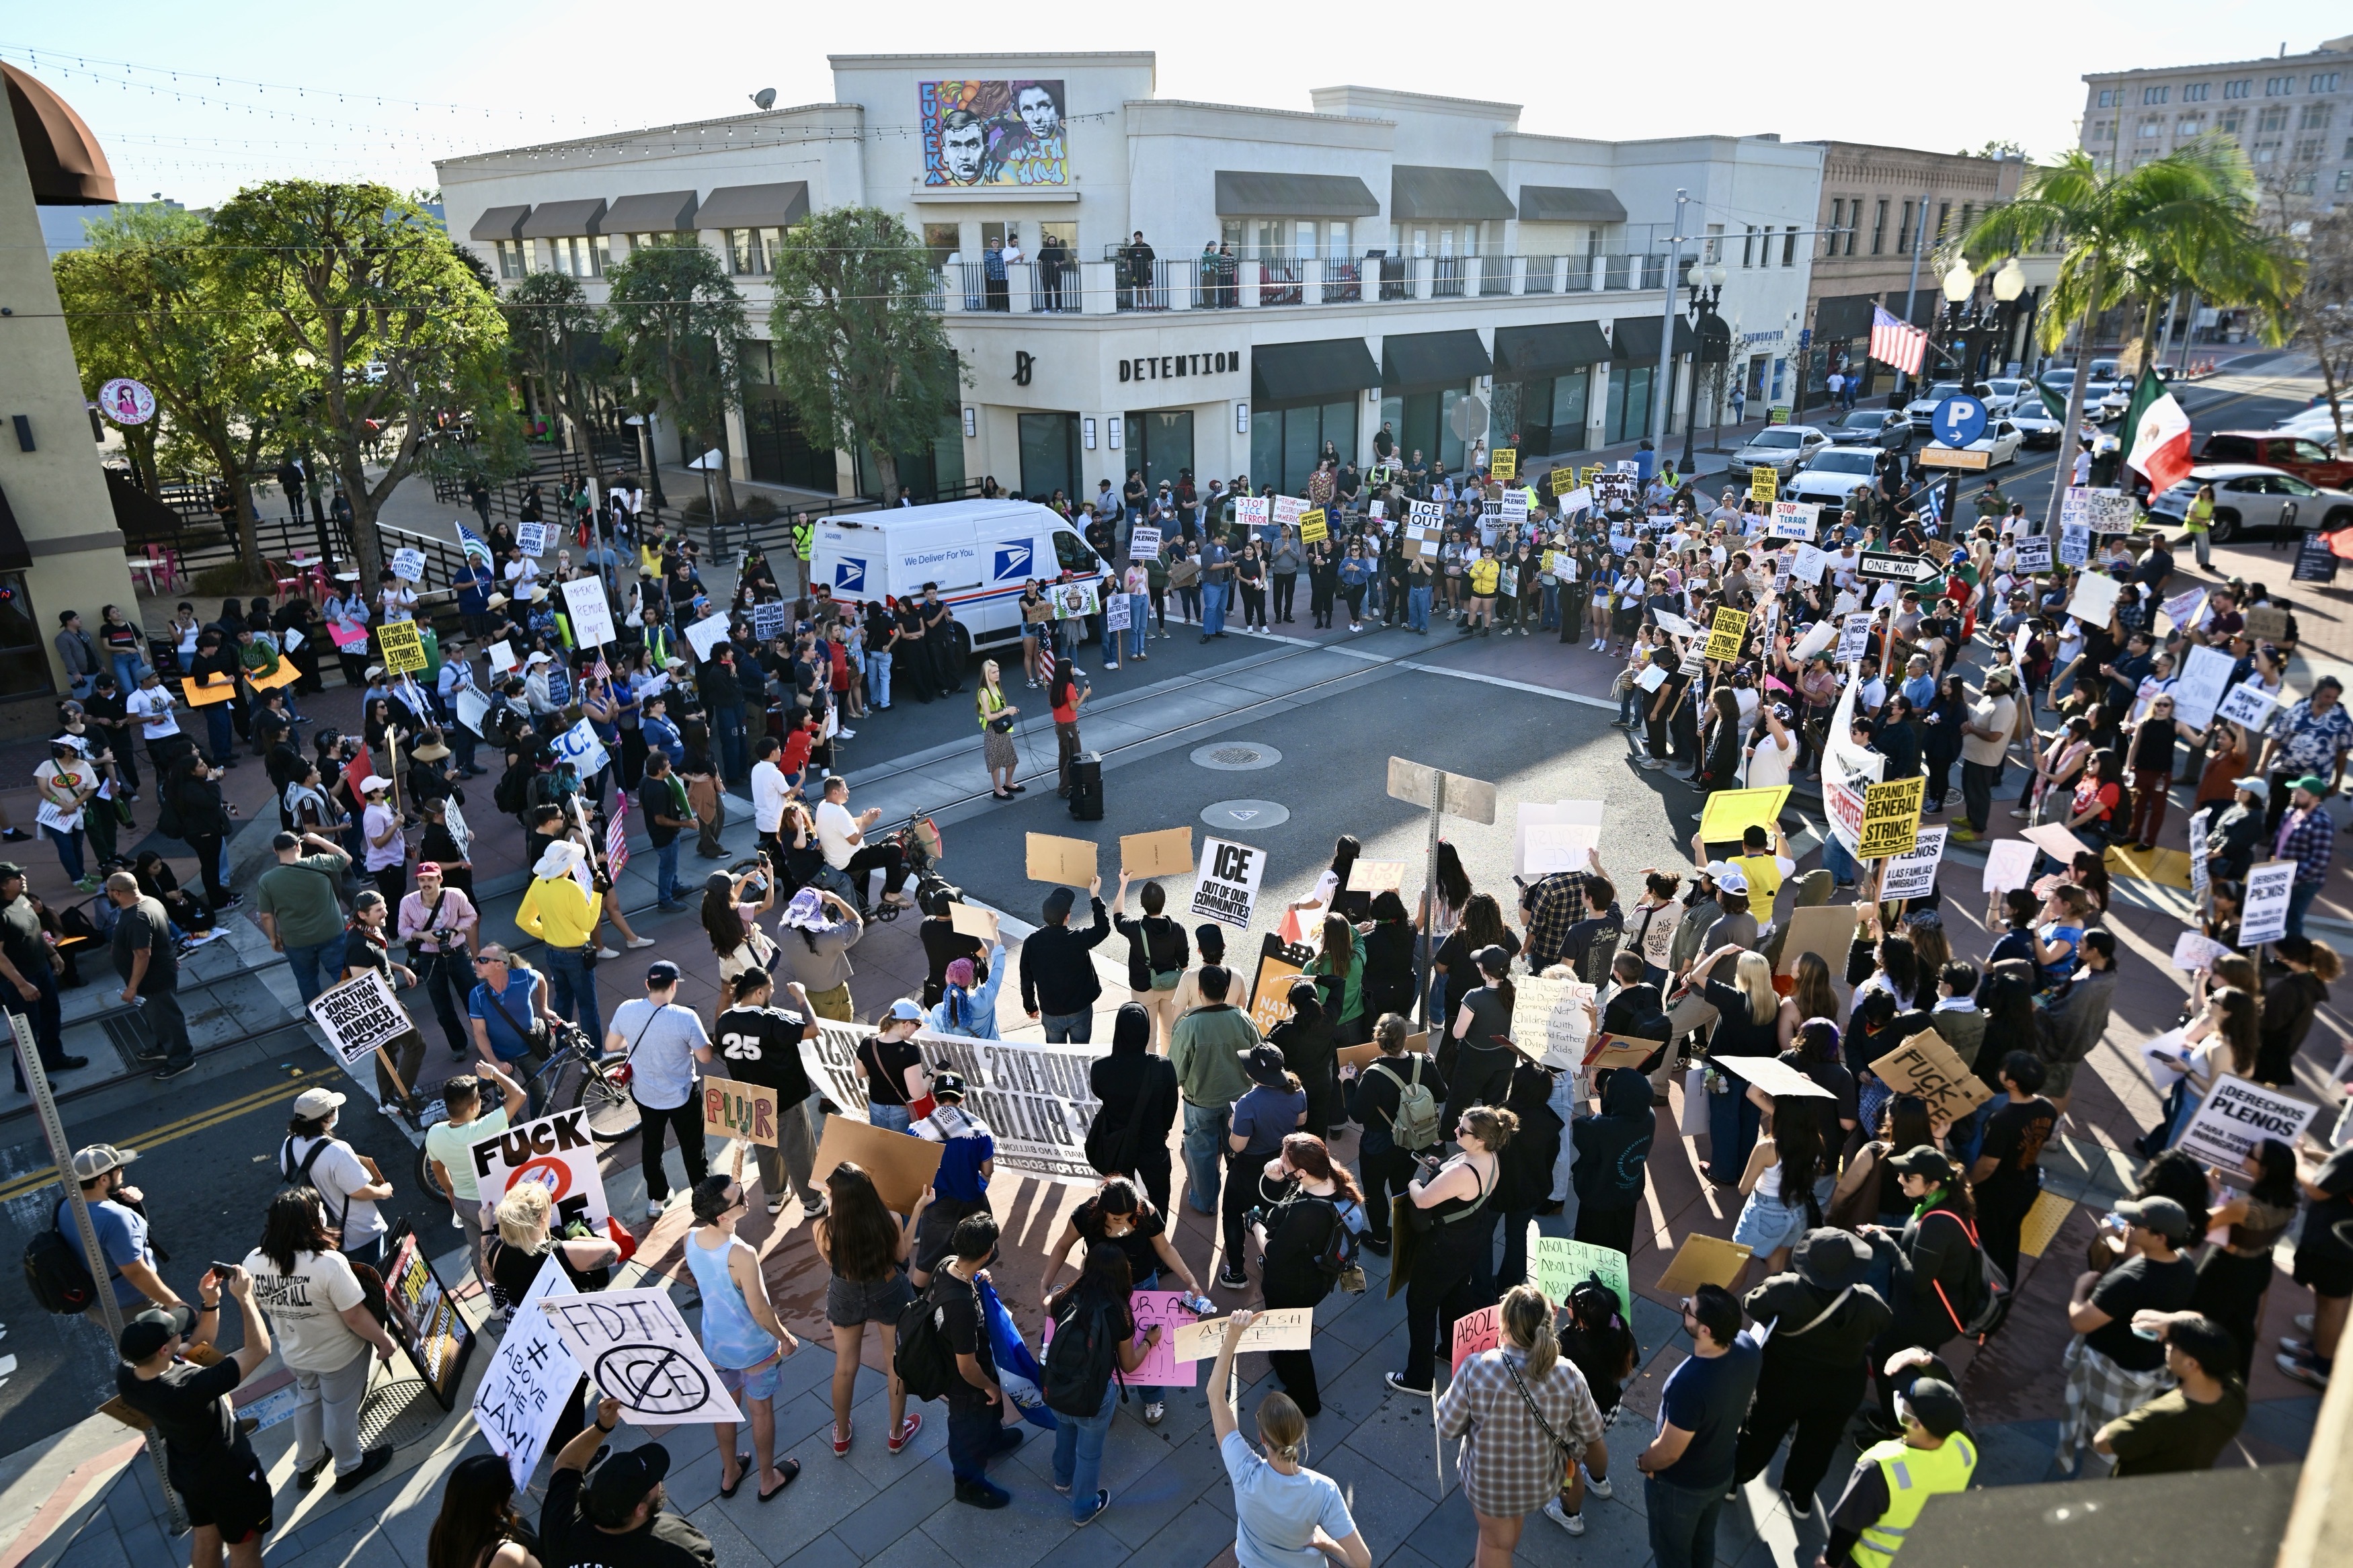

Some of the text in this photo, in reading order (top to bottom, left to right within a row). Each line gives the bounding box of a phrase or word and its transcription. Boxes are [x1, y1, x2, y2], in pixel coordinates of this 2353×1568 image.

[922, 83, 947, 185] EUREKA
[1018, 161, 1065, 184] ANA
[1119, 351, 1240, 382] DETENTION
[103, 380, 152, 401] LA MICHOACANA
[114, 414, 149, 424] EXPRESS
[1947, 401, 1975, 427] P
[1493, 456, 1514, 464] GENERAL
[1927, 451, 1981, 461] DOWNTOWN
[1753, 476, 1775, 485] GENERAL
[1754, 485, 1773, 494] STRIKE!
[1239, 499, 1265, 508] STOP
[1414, 502, 1440, 516] ICE
[2091, 493, 2130, 508] GESTAPO
[1244, 507, 1261, 515] ICE
[1302, 512, 1323, 522] ¡DERECHOS
[1370, 509, 1382, 517] OUT
[1777, 504, 1797, 515] STOP
[1238, 513, 1267, 524] TERROR
[1302, 517, 1324, 527] PLENOS
[1412, 514, 1441, 528] OUT
[1779, 515, 1807, 526] TERROR
[1918, 503, 1939, 540] ICE
[1777, 525, 1806, 538] MURDER
[2015, 537, 2048, 546] PROTESTING
[2016, 544, 2048, 554] ICE
[904, 550, 975, 566] We Deliver For You.
[2020, 556, 2027, 564] IS
[2028, 555, 2039, 563] NOT
[1866, 559, 1917, 576] ONE WAY
[568, 583, 598, 599] IMPEACH
[1060, 587, 1070, 598] ONLY
[1080, 585, 1089, 595] CAN
[575, 602, 605, 617] REMOVE
[756, 605, 783, 616] SANTA ANA
[756, 614, 783, 622] MINNEAPOLIS
[1108, 605, 1122, 614] JUSTICE
[1109, 611, 1129, 622] ALEX PRETTI
[1717, 608, 1747, 624] EXPAND THE
[379, 621, 415, 638] EXPAND THE
[757, 620, 783, 628] STOP
[766, 626, 783, 635] TERROR
[1714, 619, 1744, 636] GENERAL
[381, 631, 418, 649] GENERAL
[1712, 634, 1739, 651] STRIKE!
[388, 646, 420, 663] STRIKE!
[551, 723, 590, 764] ICE
[1868, 782, 1921, 802] EXPAND THE
[1865, 796, 1917, 820] GENERAL
[1866, 817, 1911, 842] STRIKE!
[1860, 835, 1914, 850] ICE OUT!
[1212, 843, 1253, 885] ICE
[1886, 864, 1933, 880] A LAS FAMILIAS
[1202, 880, 1249, 902] OUT OF OUR
[1886, 875, 1929, 890] INMIGRANTES
[1194, 891, 1250, 919] COMMUNITIES
[1192, 907, 1203, 915] PARTY
[1209, 911, 1225, 919] SOCIALISM
[1228, 917, 1246, 927] LIBERATION
[1269, 976, 1280, 984] BAR
[1520, 977, 1593, 1000] I Thought ICE
[315, 972, 376, 1012] ARREST
[324, 982, 380, 1020] JONATHAN
[1517, 992, 1577, 1012] Was Deporting
[331, 995, 385, 1030] ROSS FOR
[1554, 1005, 1572, 1016] Not
[336, 1004, 397, 1045] MURDER
[1513, 1012, 1552, 1027] Children
[342, 1014, 405, 1057] NOW!
[348, 1048, 360, 1061] PARTY
[358, 1046, 367, 1055] FOR
[365, 1036, 383, 1051] SOCIALISM
[387, 1024, 408, 1038] LIBERATION
[1512, 1026, 1587, 1044] Cancer and Fathers
[722, 1032, 762, 1061] 25
[1511, 1034, 1573, 1055] of Dying Kids
[946, 1075, 955, 1086] LA
[1892, 1048, 1958, 1102] FUCK
[2219, 1084, 2307, 1123] ¡DERECHOS
[706, 1088, 774, 1140] PLUR
[2209, 1096, 2297, 1139] PLENOS
[472, 1110, 592, 1179] FUCK
[1539, 1239, 1620, 1268] ABOLISH ICE
[405, 1257, 428, 1304] OPEN
[1541, 1257, 1620, 1288] ABOLISH ICE
[251, 1274, 310, 1298] LEGALIZATION
[270, 1284, 313, 1307] FOR ALL
[561, 1298, 684, 1346] FDT!
[428, 1305, 451, 1383] CHAMPURRADO
[502, 1343, 549, 1413] ABOVE
[605, 1352, 701, 1408] ICE
[504, 1375, 528, 1416] THE
[239, 1407, 253, 1417] TO
[480, 1385, 535, 1464] LAW!
